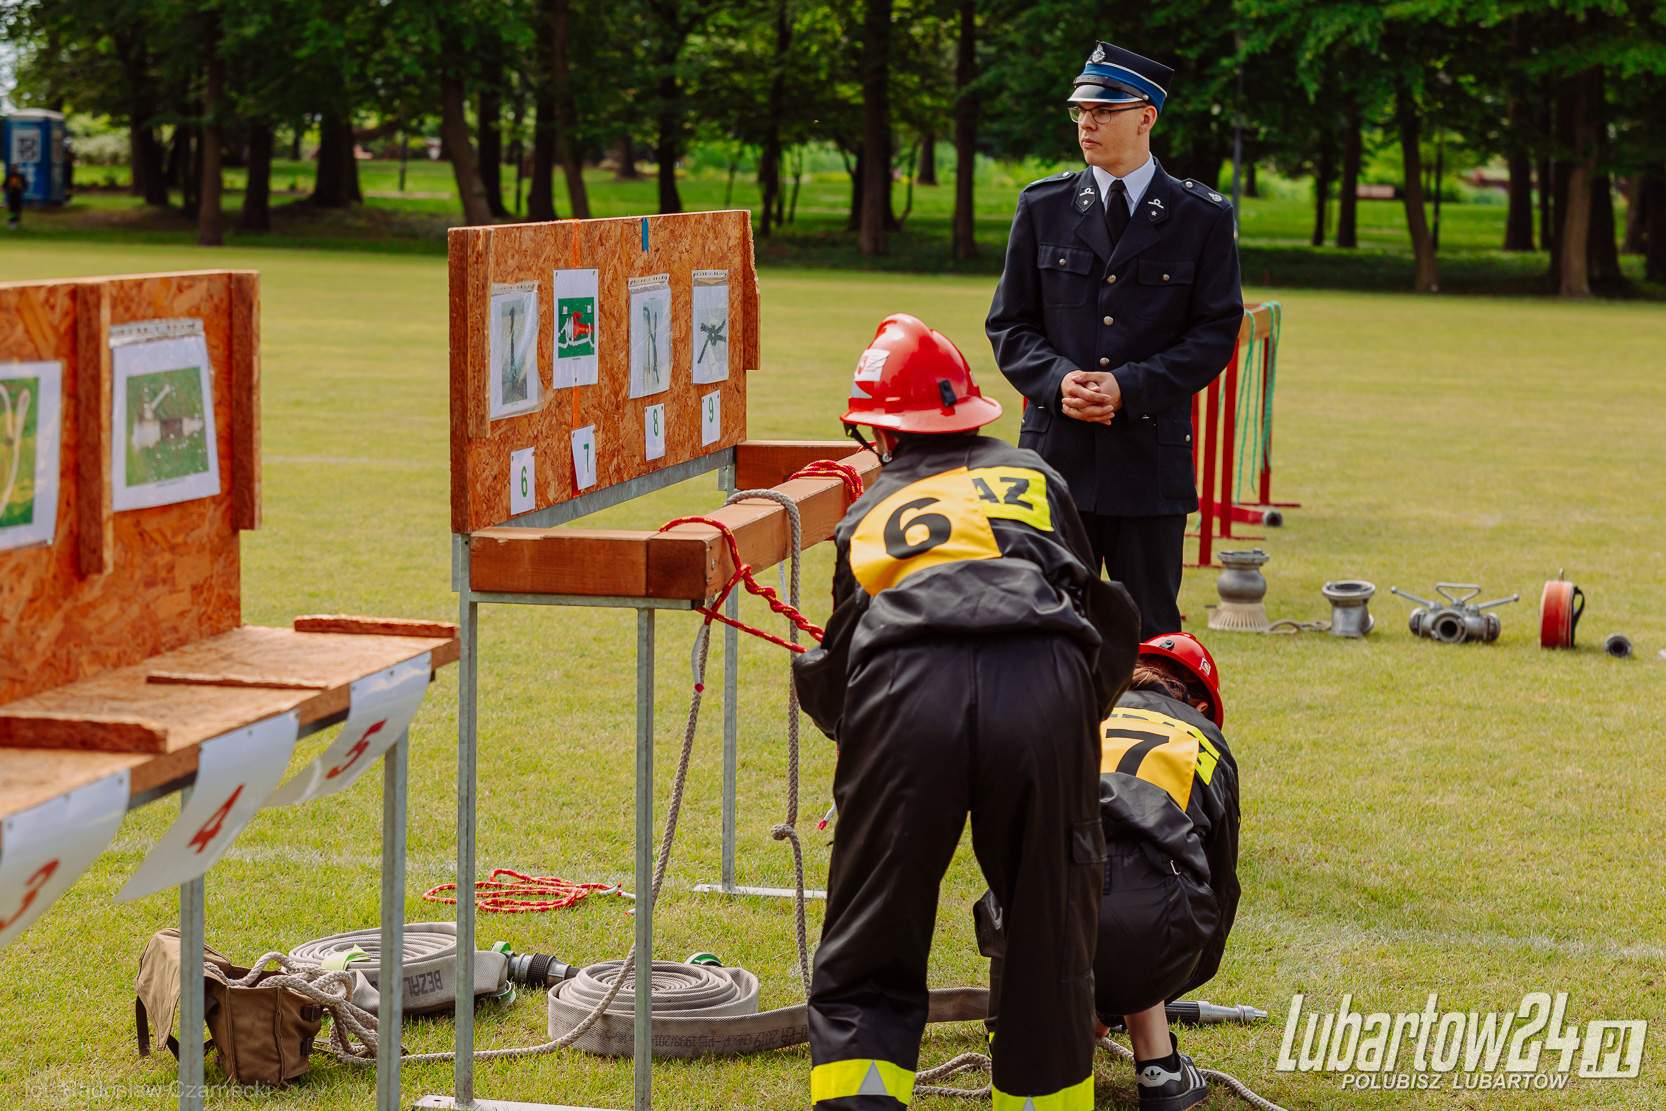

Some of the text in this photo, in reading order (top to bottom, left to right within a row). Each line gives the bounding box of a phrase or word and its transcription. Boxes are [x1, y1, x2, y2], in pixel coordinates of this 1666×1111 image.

[652, 408, 660, 437] 8
[708, 393, 715, 423] 9
[520, 465, 529, 497] 6
[583, 443, 590, 473] 7
[883, 496, 952, 559] 6
[325, 718, 389, 780] 5
[1105, 728, 1170, 777] 7
[187, 783, 245, 854] 4
[0, 858, 60, 932] 3
